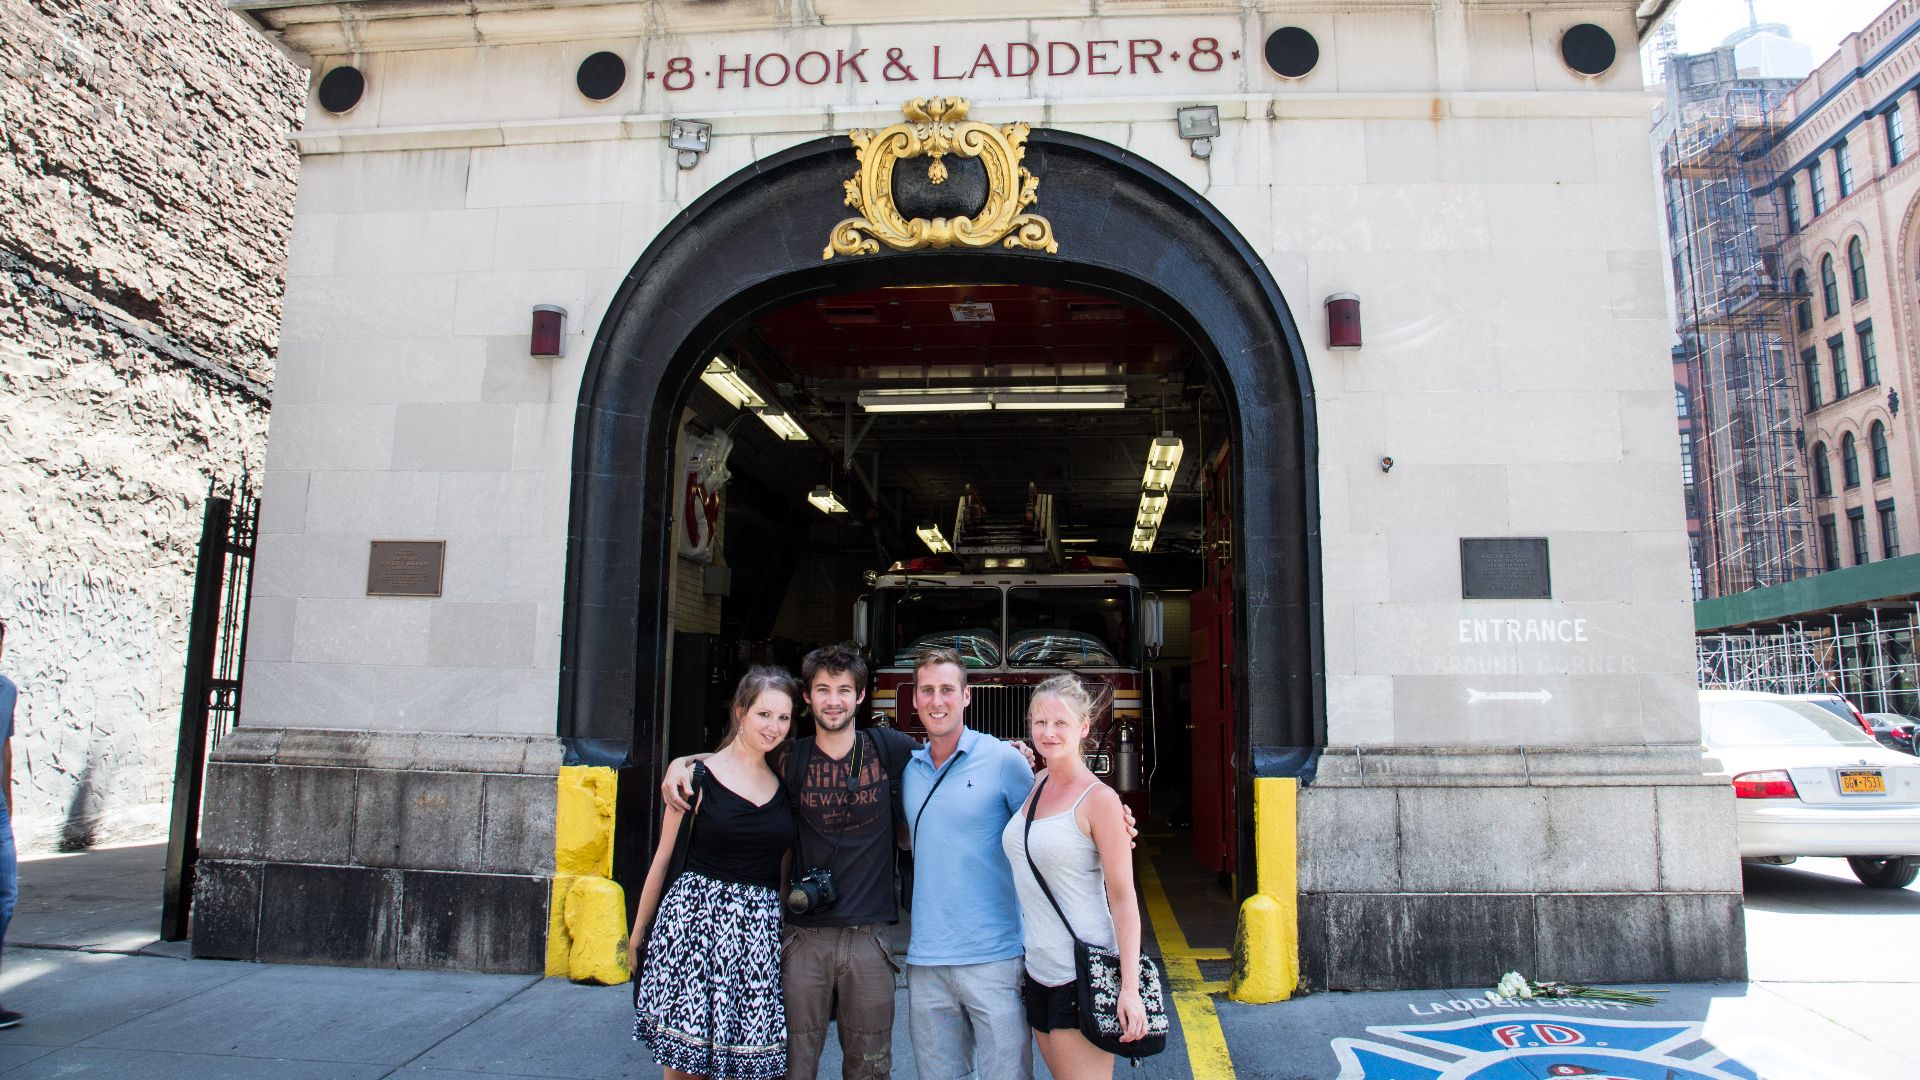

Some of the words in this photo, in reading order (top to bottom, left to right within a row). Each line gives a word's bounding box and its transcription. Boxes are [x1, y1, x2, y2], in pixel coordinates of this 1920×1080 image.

[882, 47, 919, 82] &
[1459, 618, 1588, 643] ENTRANCE
[1434, 655, 1525, 674] AROUND
[1536, 655, 1637, 674] CORNER
[800, 791, 833, 807] NEW
[834, 786, 879, 806] YORK
